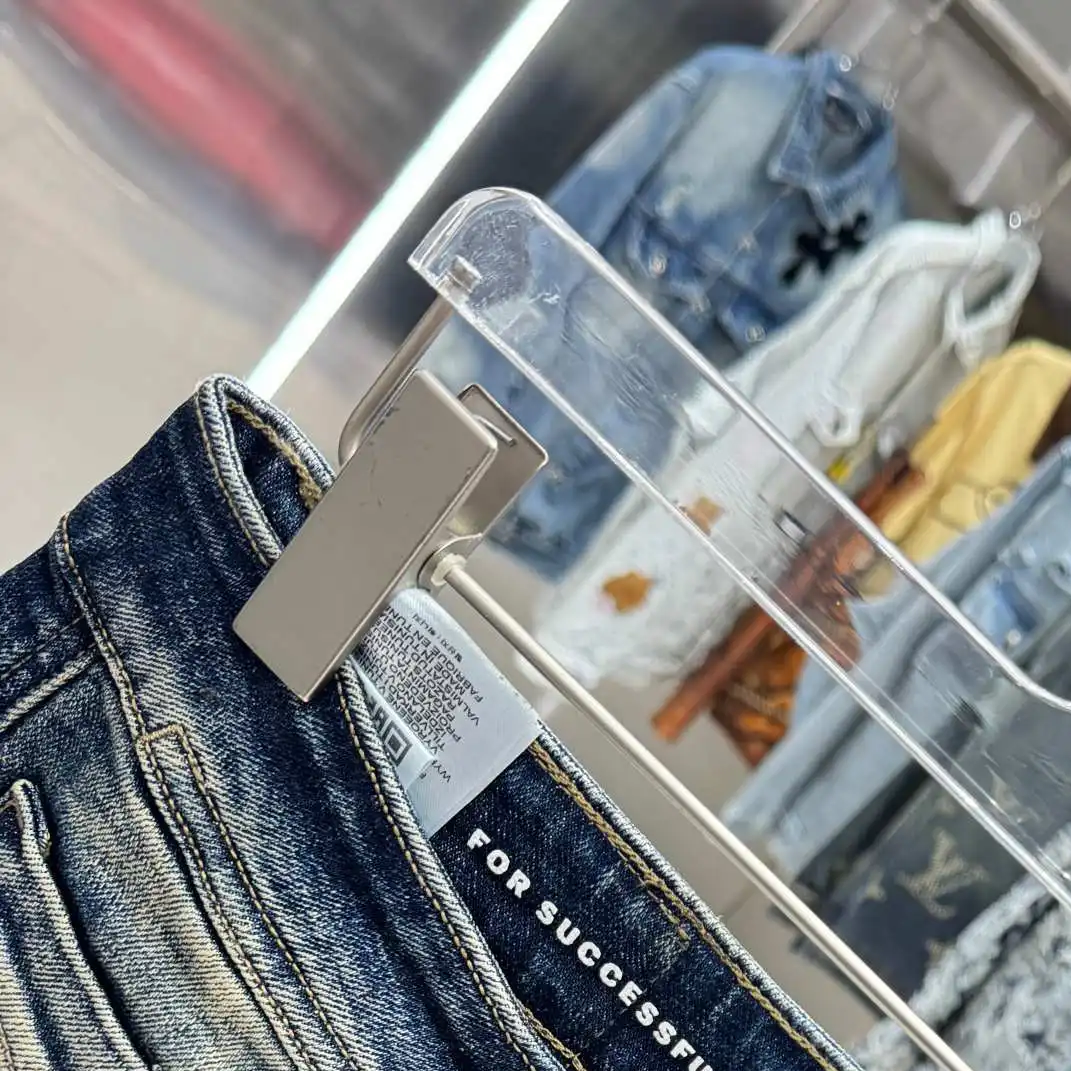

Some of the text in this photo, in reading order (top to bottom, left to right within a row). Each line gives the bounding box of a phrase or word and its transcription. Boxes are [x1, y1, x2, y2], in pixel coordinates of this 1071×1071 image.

[379, 653, 389, 664] U
[412, 629, 431, 647] EN
[420, 649, 434, 663] IN
[388, 663, 462, 741] PROIZVEDENO
[409, 651, 482, 725] VALMISTATUD
[433, 662, 465, 695] MADE
[387, 684, 447, 750] TILLVERKAD
[395, 682, 446, 737] IZDELANO
[467, 828, 531, 899] FOR
